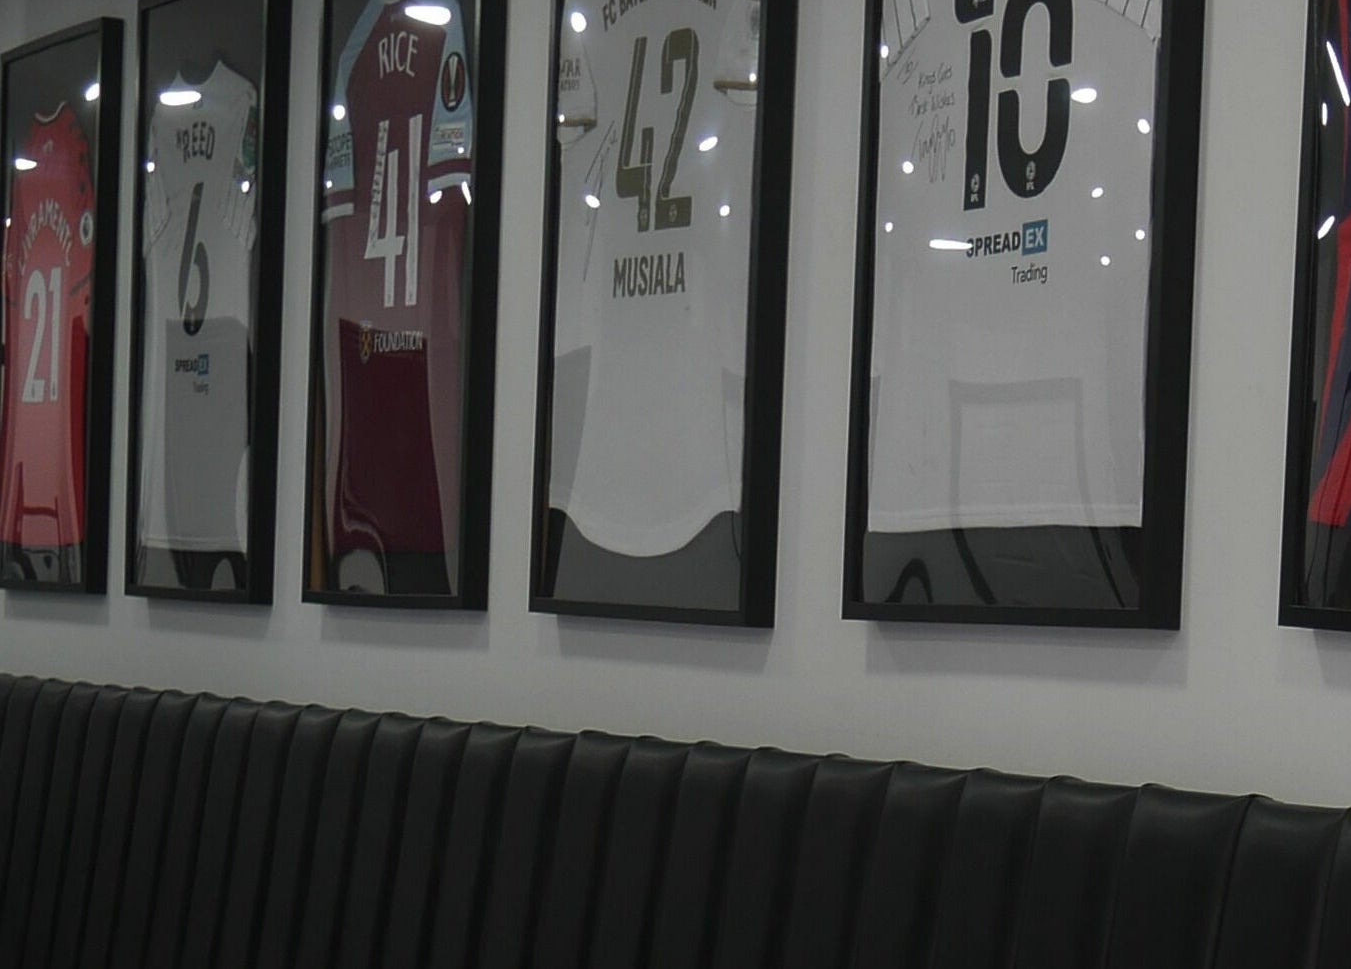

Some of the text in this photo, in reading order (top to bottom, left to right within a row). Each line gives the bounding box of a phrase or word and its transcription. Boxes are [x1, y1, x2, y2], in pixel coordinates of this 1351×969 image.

[378, 30, 419, 80] RICE
[181, 120, 216, 164] REED
[616, 27, 699, 233] 42
[364, 113, 423, 309] 41
[177, 181, 211, 337] 6
[966, 223, 1047, 259] SPREADEX
[612, 251, 687, 299] MUSIALA
[1011, 262, 1049, 285] Trading
[21, 266, 63, 404] 21
[373, 330, 424, 354] FOUNDATION
